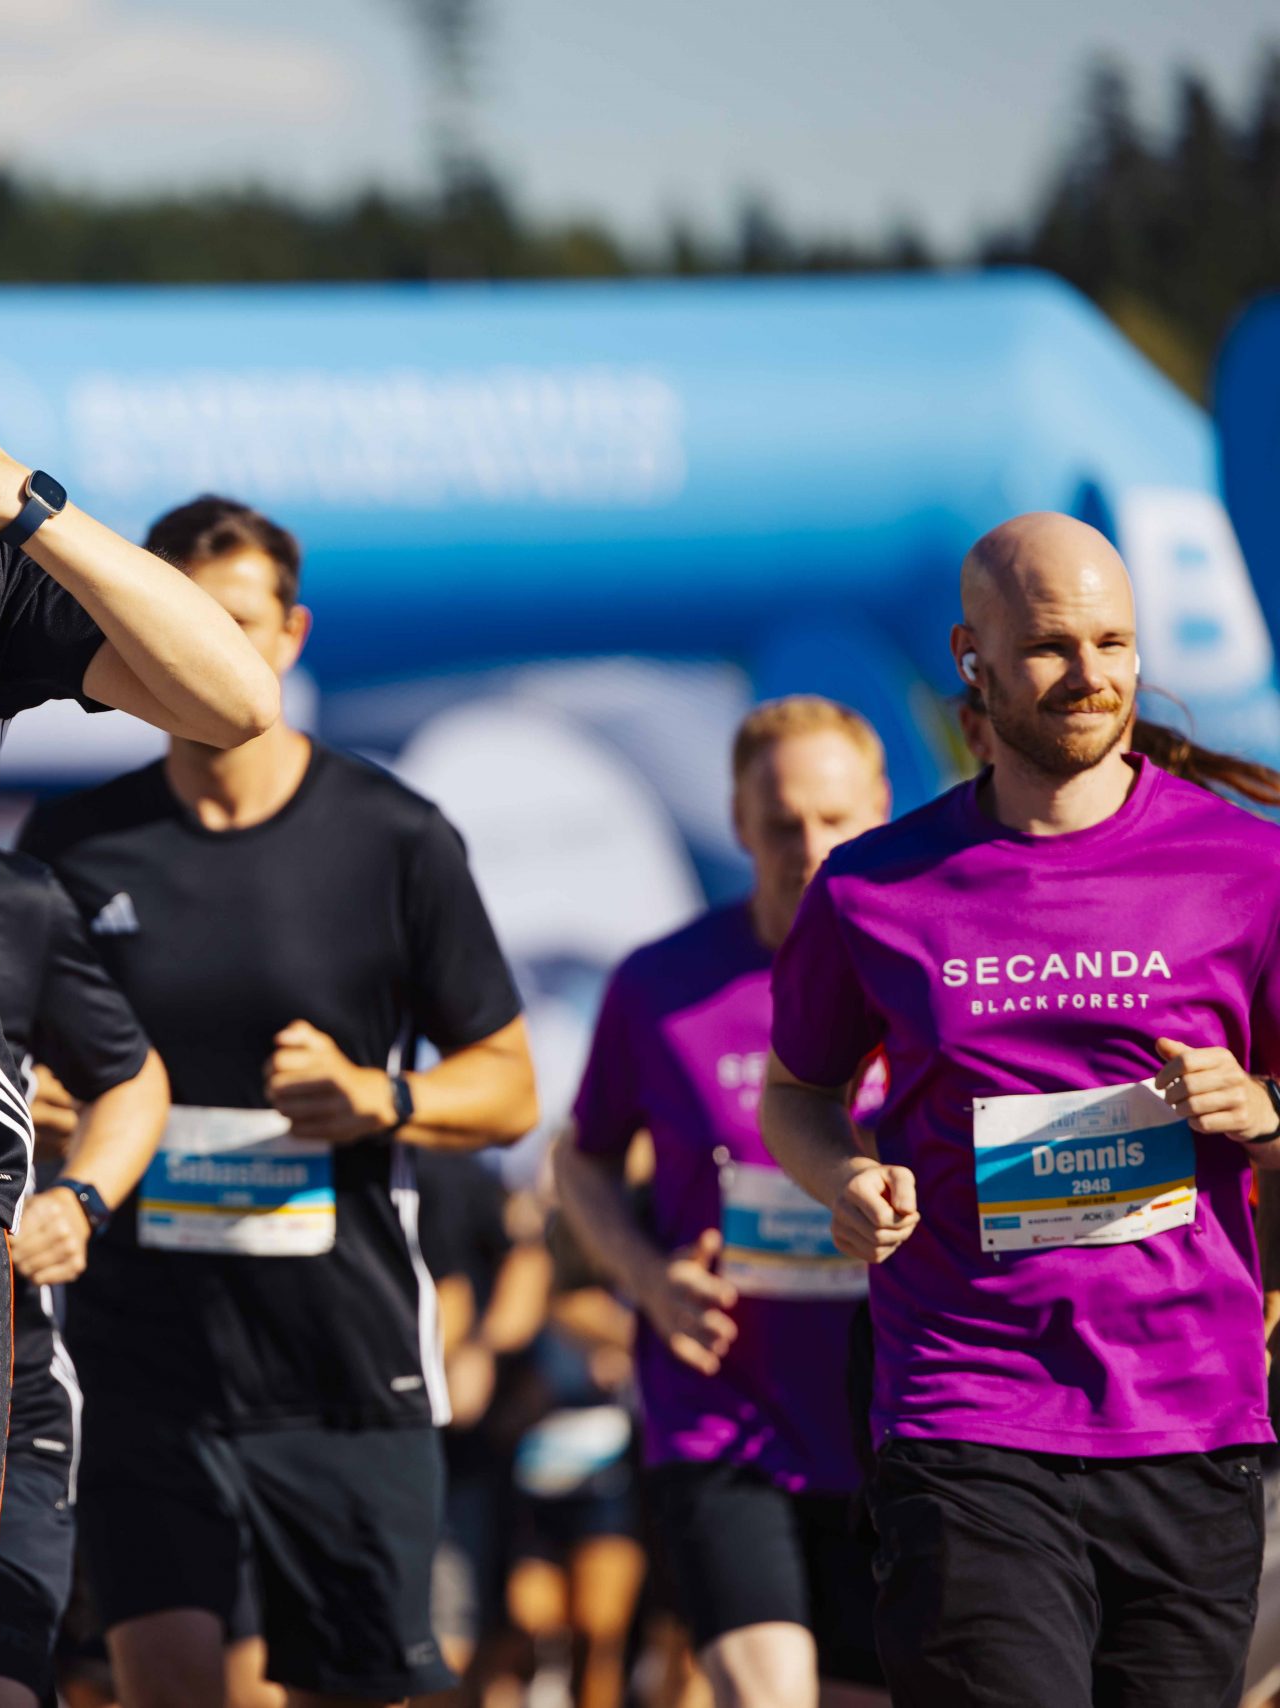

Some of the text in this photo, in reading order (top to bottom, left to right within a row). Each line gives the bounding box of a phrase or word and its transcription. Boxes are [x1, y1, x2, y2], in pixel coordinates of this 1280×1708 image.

[942, 950, 1172, 987] SECANDA
[971, 993, 1150, 1015] BLACK FOREST
[1031, 1139, 1145, 1176] Dennis
[1072, 1178, 1111, 1195] 2948
